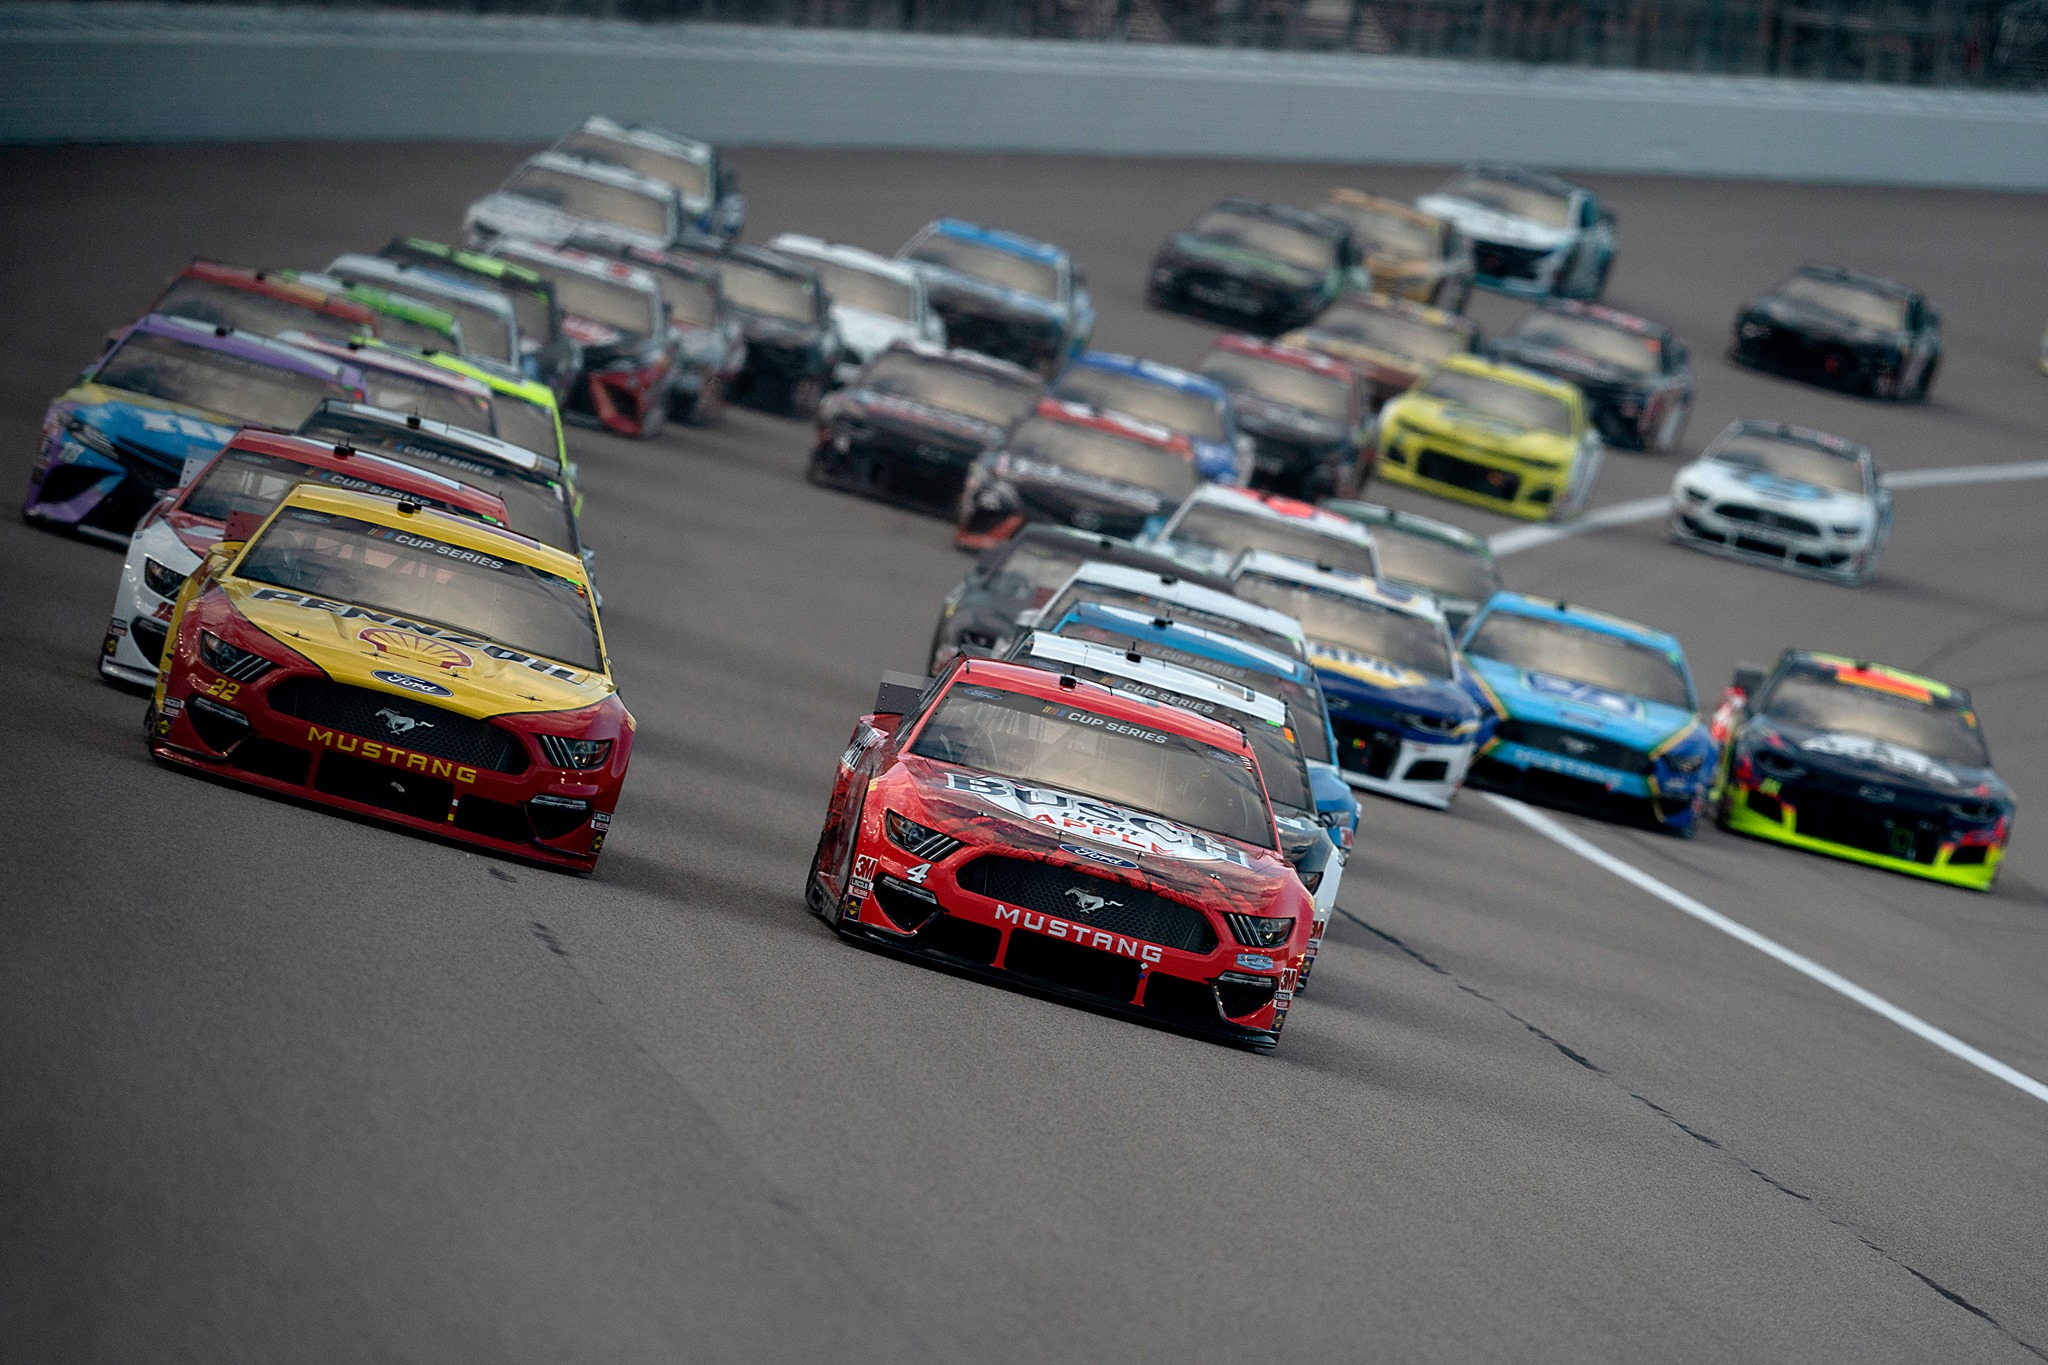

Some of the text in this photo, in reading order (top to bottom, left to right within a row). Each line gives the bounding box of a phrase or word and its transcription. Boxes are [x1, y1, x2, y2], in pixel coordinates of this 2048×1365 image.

[330, 475, 367, 489] CUP
[395, 534, 504, 570] CUP SERIES
[250, 587, 590, 687] PENNZOIL
[1194, 657, 1247, 679] SERIES
[207, 677, 240, 702] 22
[388, 673, 437, 692] Ford
[1123, 682, 1217, 714] CUP SERIES
[1067, 711, 1169, 745] CUP SERIES
[307, 726, 477, 784] MUSTANG
[945, 772, 1252, 869] BUSCH
[1061, 812, 1145, 836] LIGHT
[1032, 813, 1174, 856] APPLE
[855, 856, 876, 880] 3M
[1074, 848, 1123, 864] Ford
[907, 862, 932, 884] 4
[994, 904, 1163, 963] MUSTANG
[1280, 969, 1296, 991] 3M
